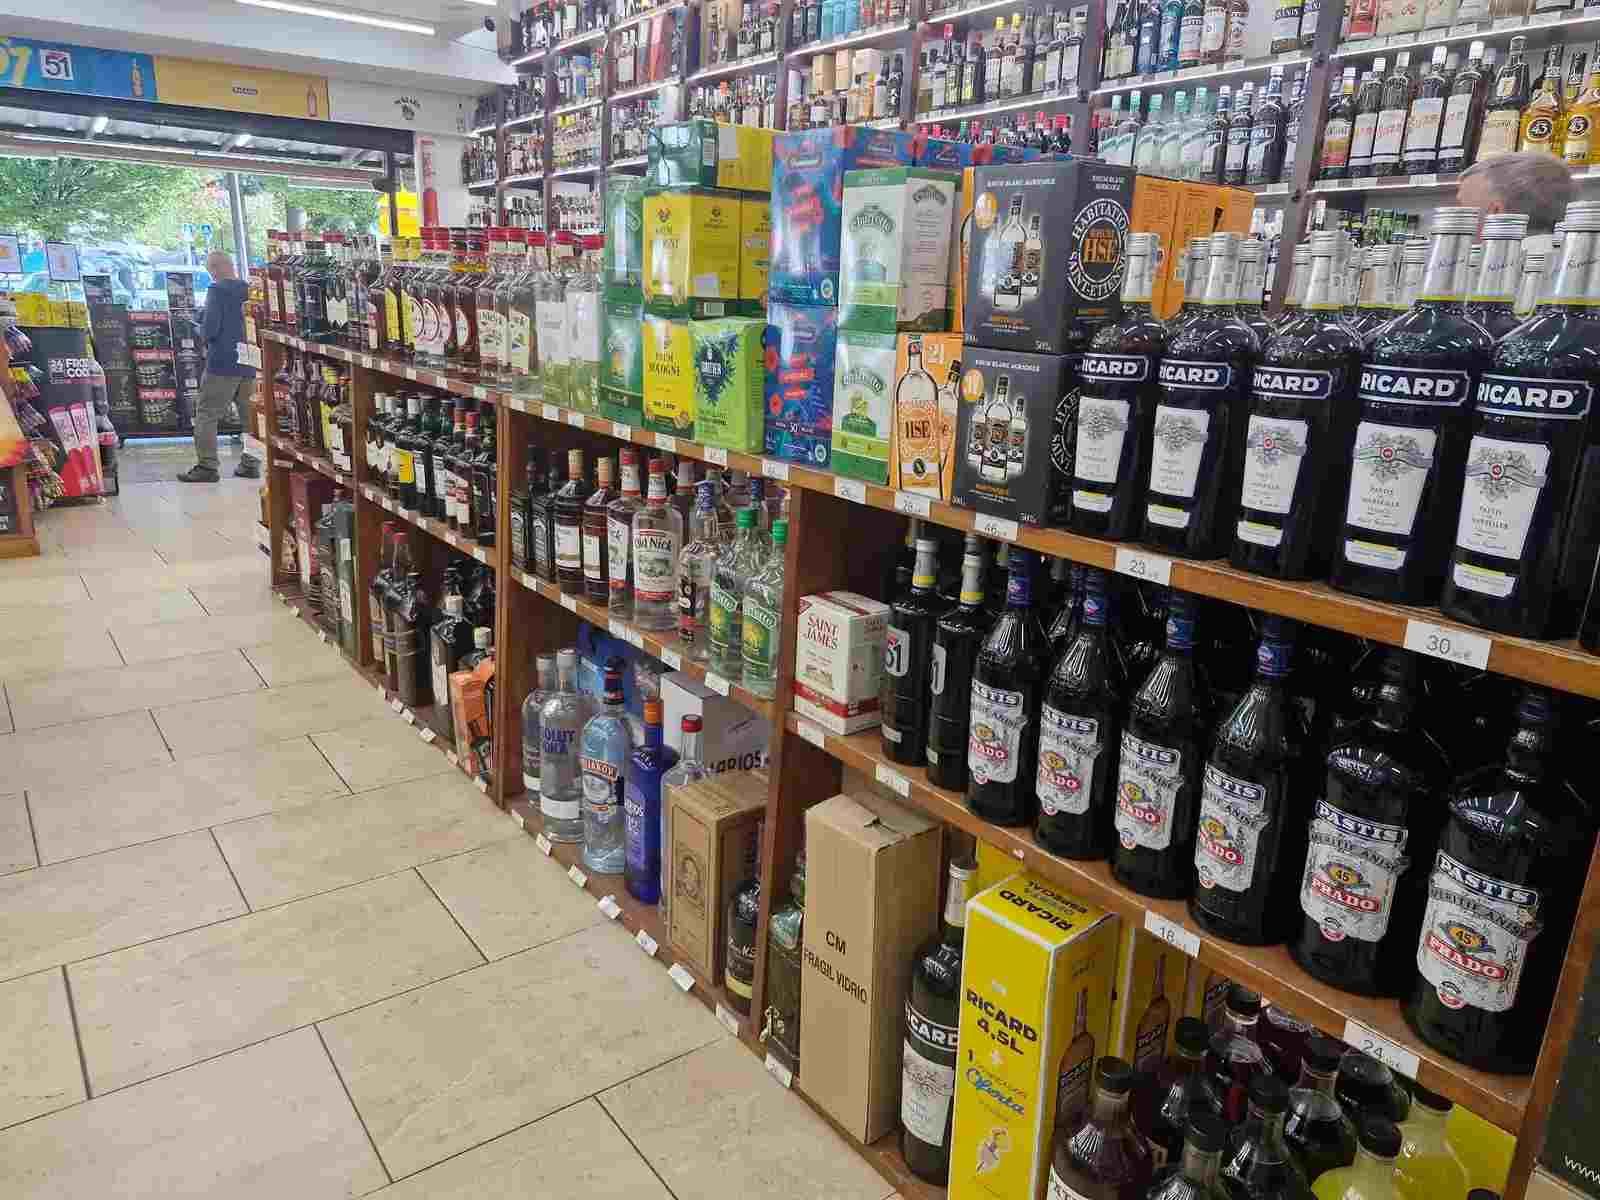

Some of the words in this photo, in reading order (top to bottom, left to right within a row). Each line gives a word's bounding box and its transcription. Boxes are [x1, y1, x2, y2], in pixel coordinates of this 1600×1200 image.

[45, 55, 70, 78] 51
[1084, 238, 1117, 263] HSE
[1360, 371, 1456, 398] RICARD
[1477, 381, 1575, 410] RICARD
[904, 419, 931, 439] HSE
[806, 613, 840, 634] SAINT
[804, 629, 839, 649] JAMES
[1317, 803, 1404, 843] PASTIS
[1438, 855, 1537, 905] PASTIS
[999, 889, 1074, 931] RICARD
[824, 929, 847, 957] CM
[1456, 929, 1473, 946] 45
[802, 949, 835, 983] FRAGIL
[835, 967, 869, 1005] VIDRIO
[966, 988, 1039, 1043] RICARD
